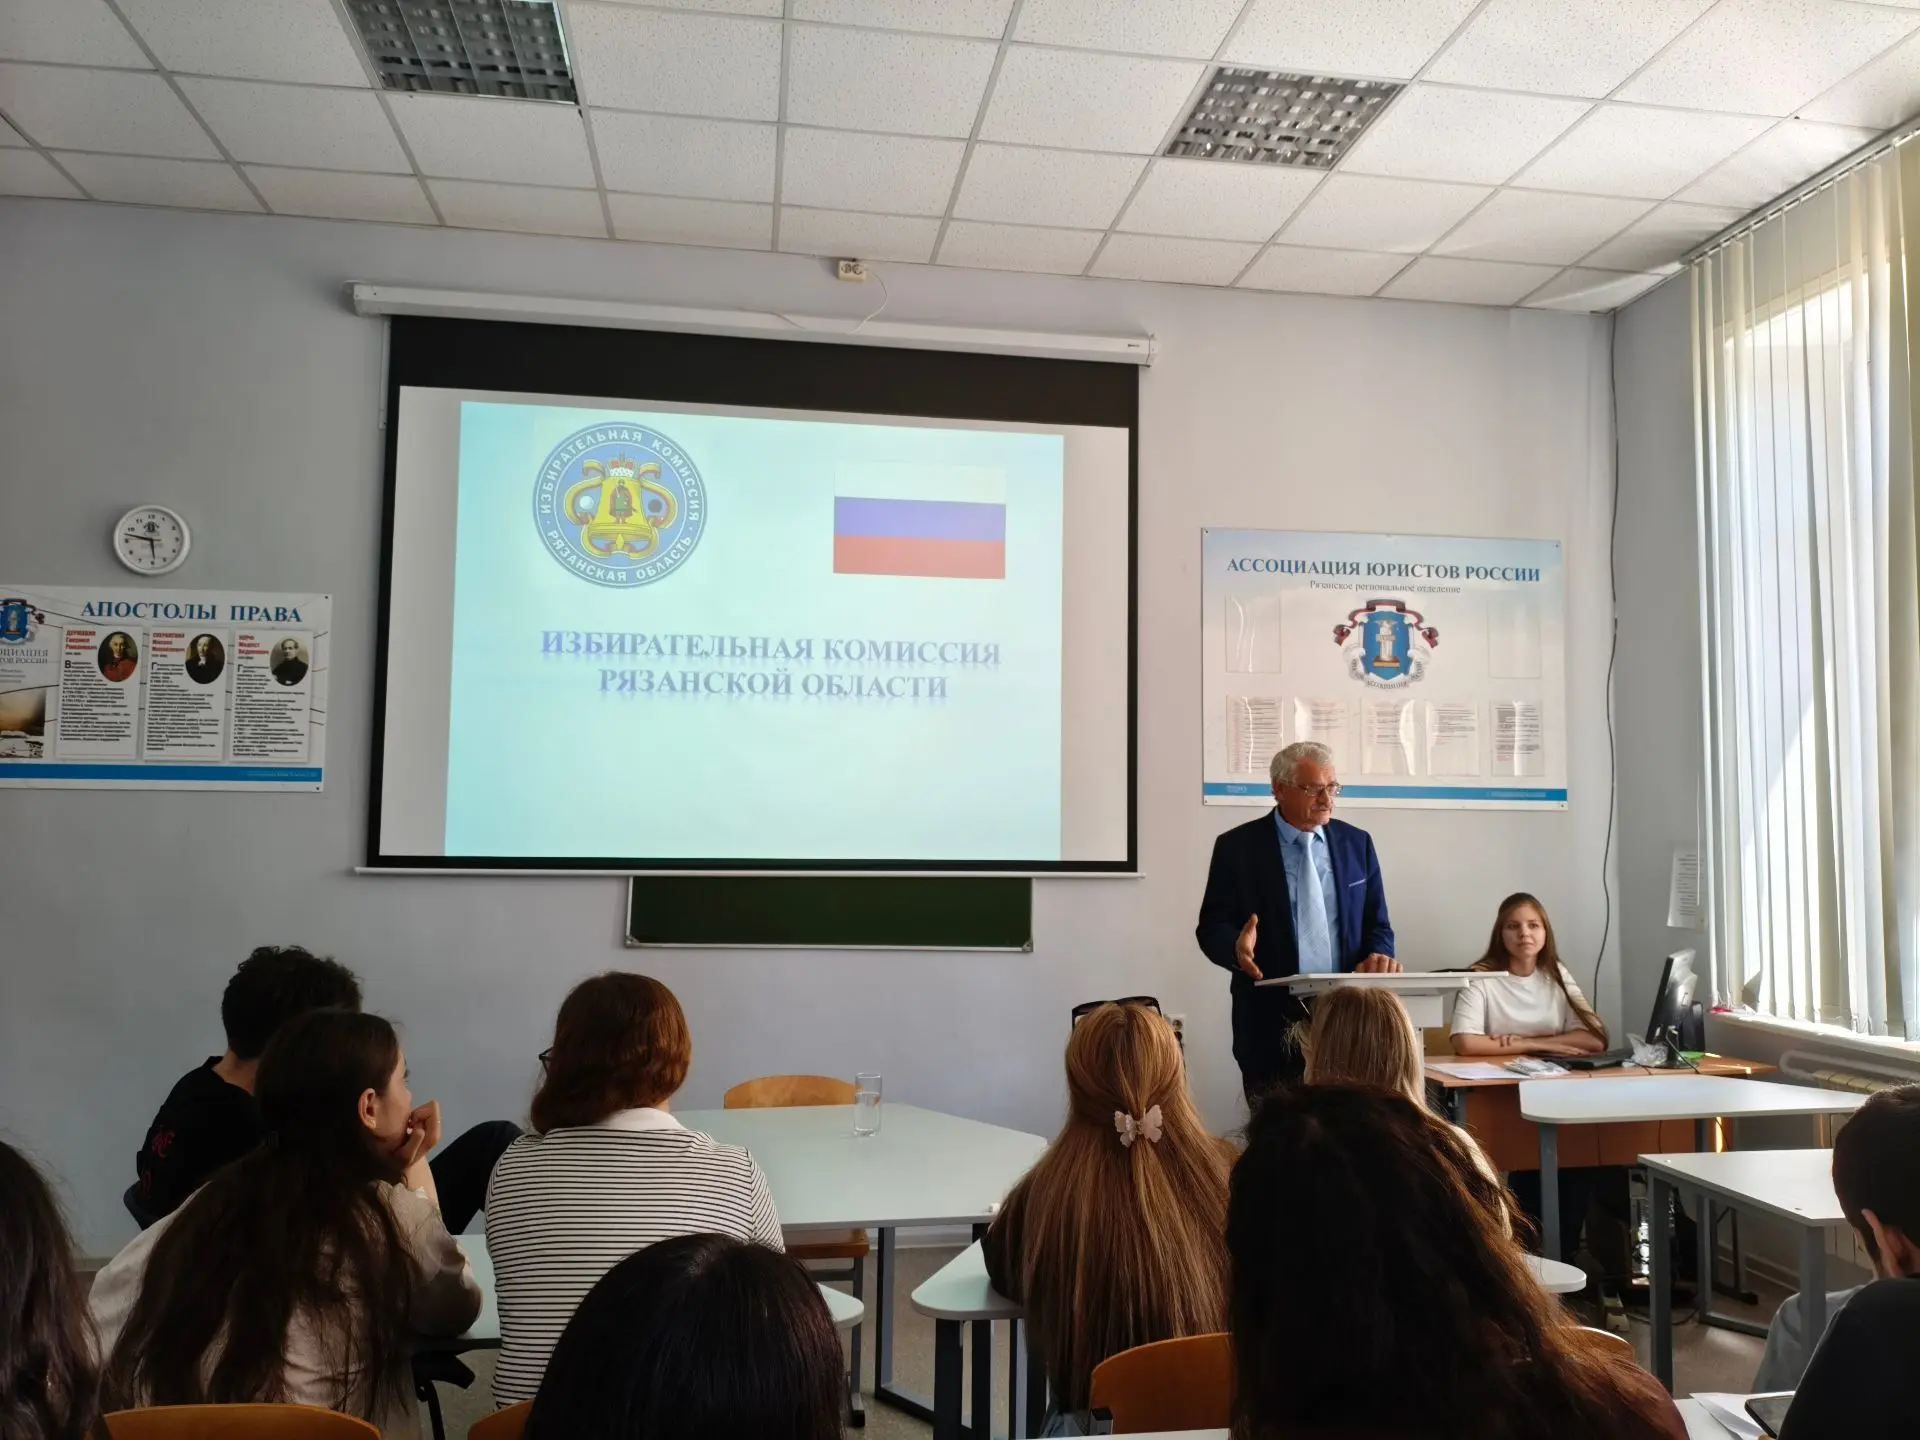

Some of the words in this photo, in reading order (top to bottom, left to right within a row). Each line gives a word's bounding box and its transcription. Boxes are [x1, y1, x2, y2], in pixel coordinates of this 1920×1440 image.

[541, 429, 642, 514] ИЗБИРАТЕЛЬНАЯ
[651, 439, 700, 521] КОМИССИЯ
[548, 530, 627, 582] РЯЗАНСКАЯ
[636, 536, 692, 580] ОБЛАСТЬ
[1226, 558, 1361, 577] АССОЦИАЦИЯ
[1366, 562, 1460, 579] ЮРИСТОВ
[1465, 565, 1540, 583] РОССИИ
[1309, 580, 1353, 591] Рязанское
[1356, 583, 1415, 593] региональное
[1417, 586, 1461, 594] отделение
[81, 601, 217, 620] АПОСТОЛЫ
[230, 605, 302, 622] ПРАВА
[541, 631, 813, 660] ИЗБИРАТЕЛЬНАЯ
[823, 638, 1001, 665] КОМИССИЯ
[598, 668, 792, 695] РЯЗАНСКОЙ
[802, 673, 949, 698] ОБЛАСТИ
